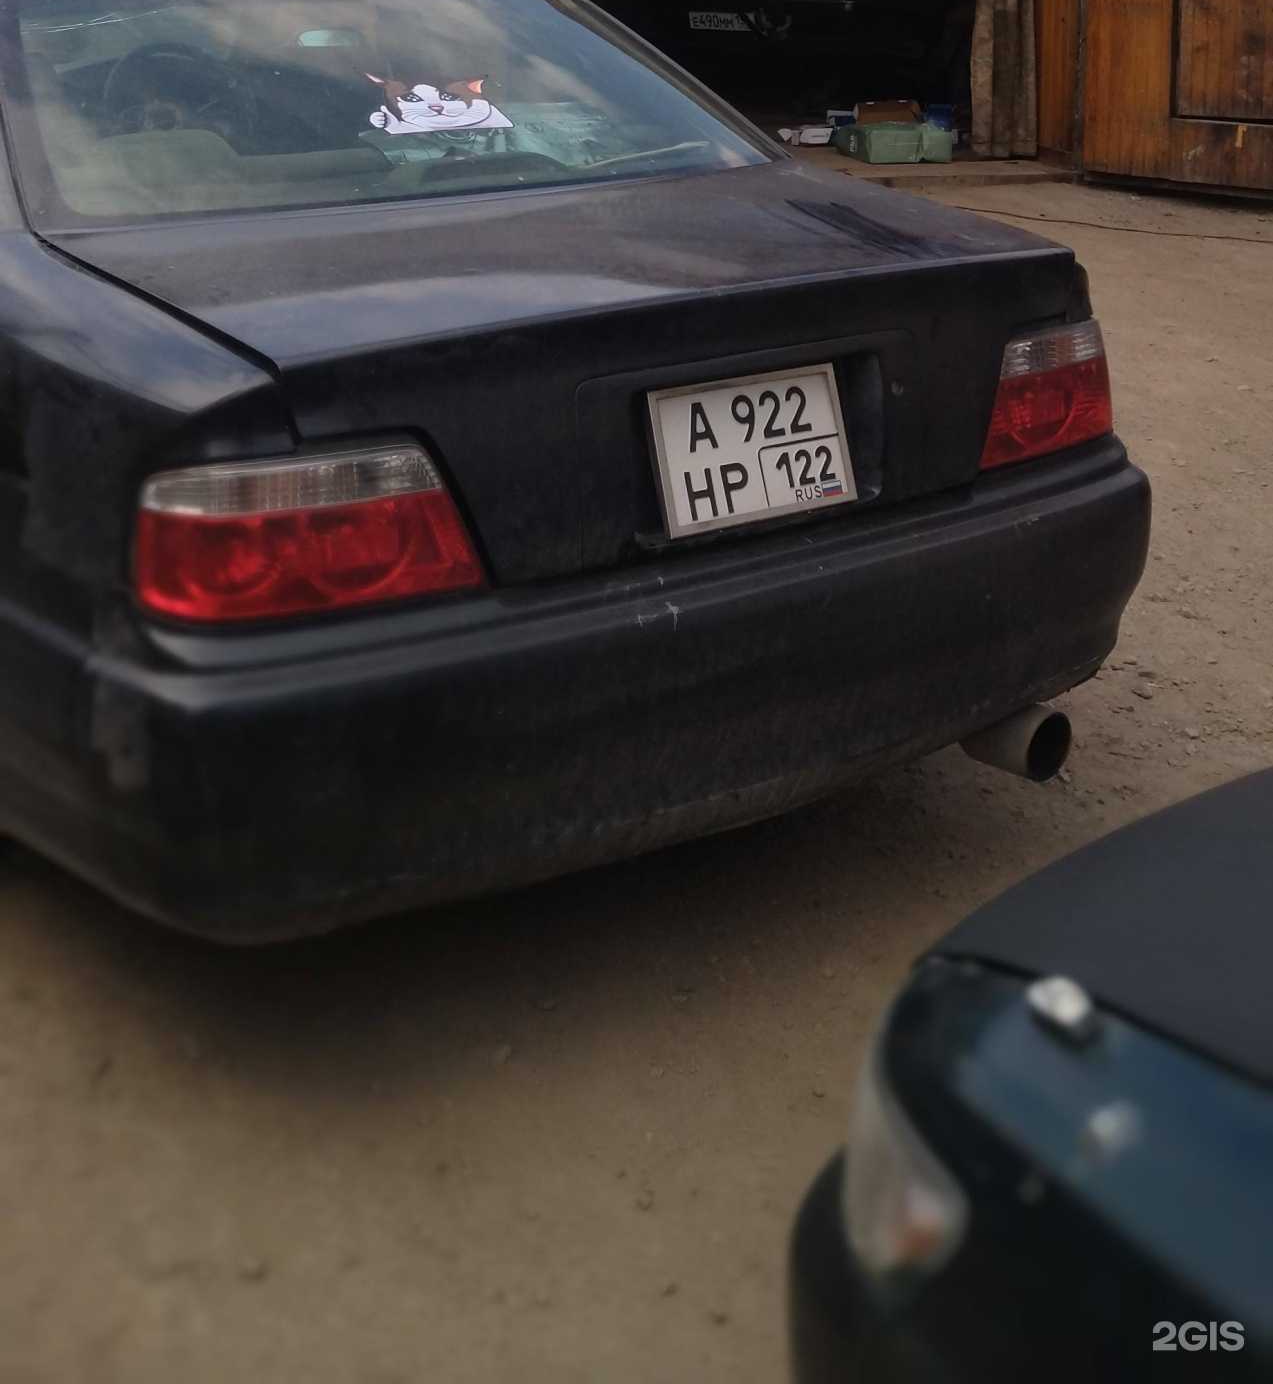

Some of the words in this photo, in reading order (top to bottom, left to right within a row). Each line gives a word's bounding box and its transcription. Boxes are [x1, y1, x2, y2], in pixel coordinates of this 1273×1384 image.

[690, 402, 719, 453] А
[731, 386, 812, 443] 922
[684, 463, 748, 521] НР
[776, 445, 836, 489] 122
[795, 485, 822, 503] RUS
